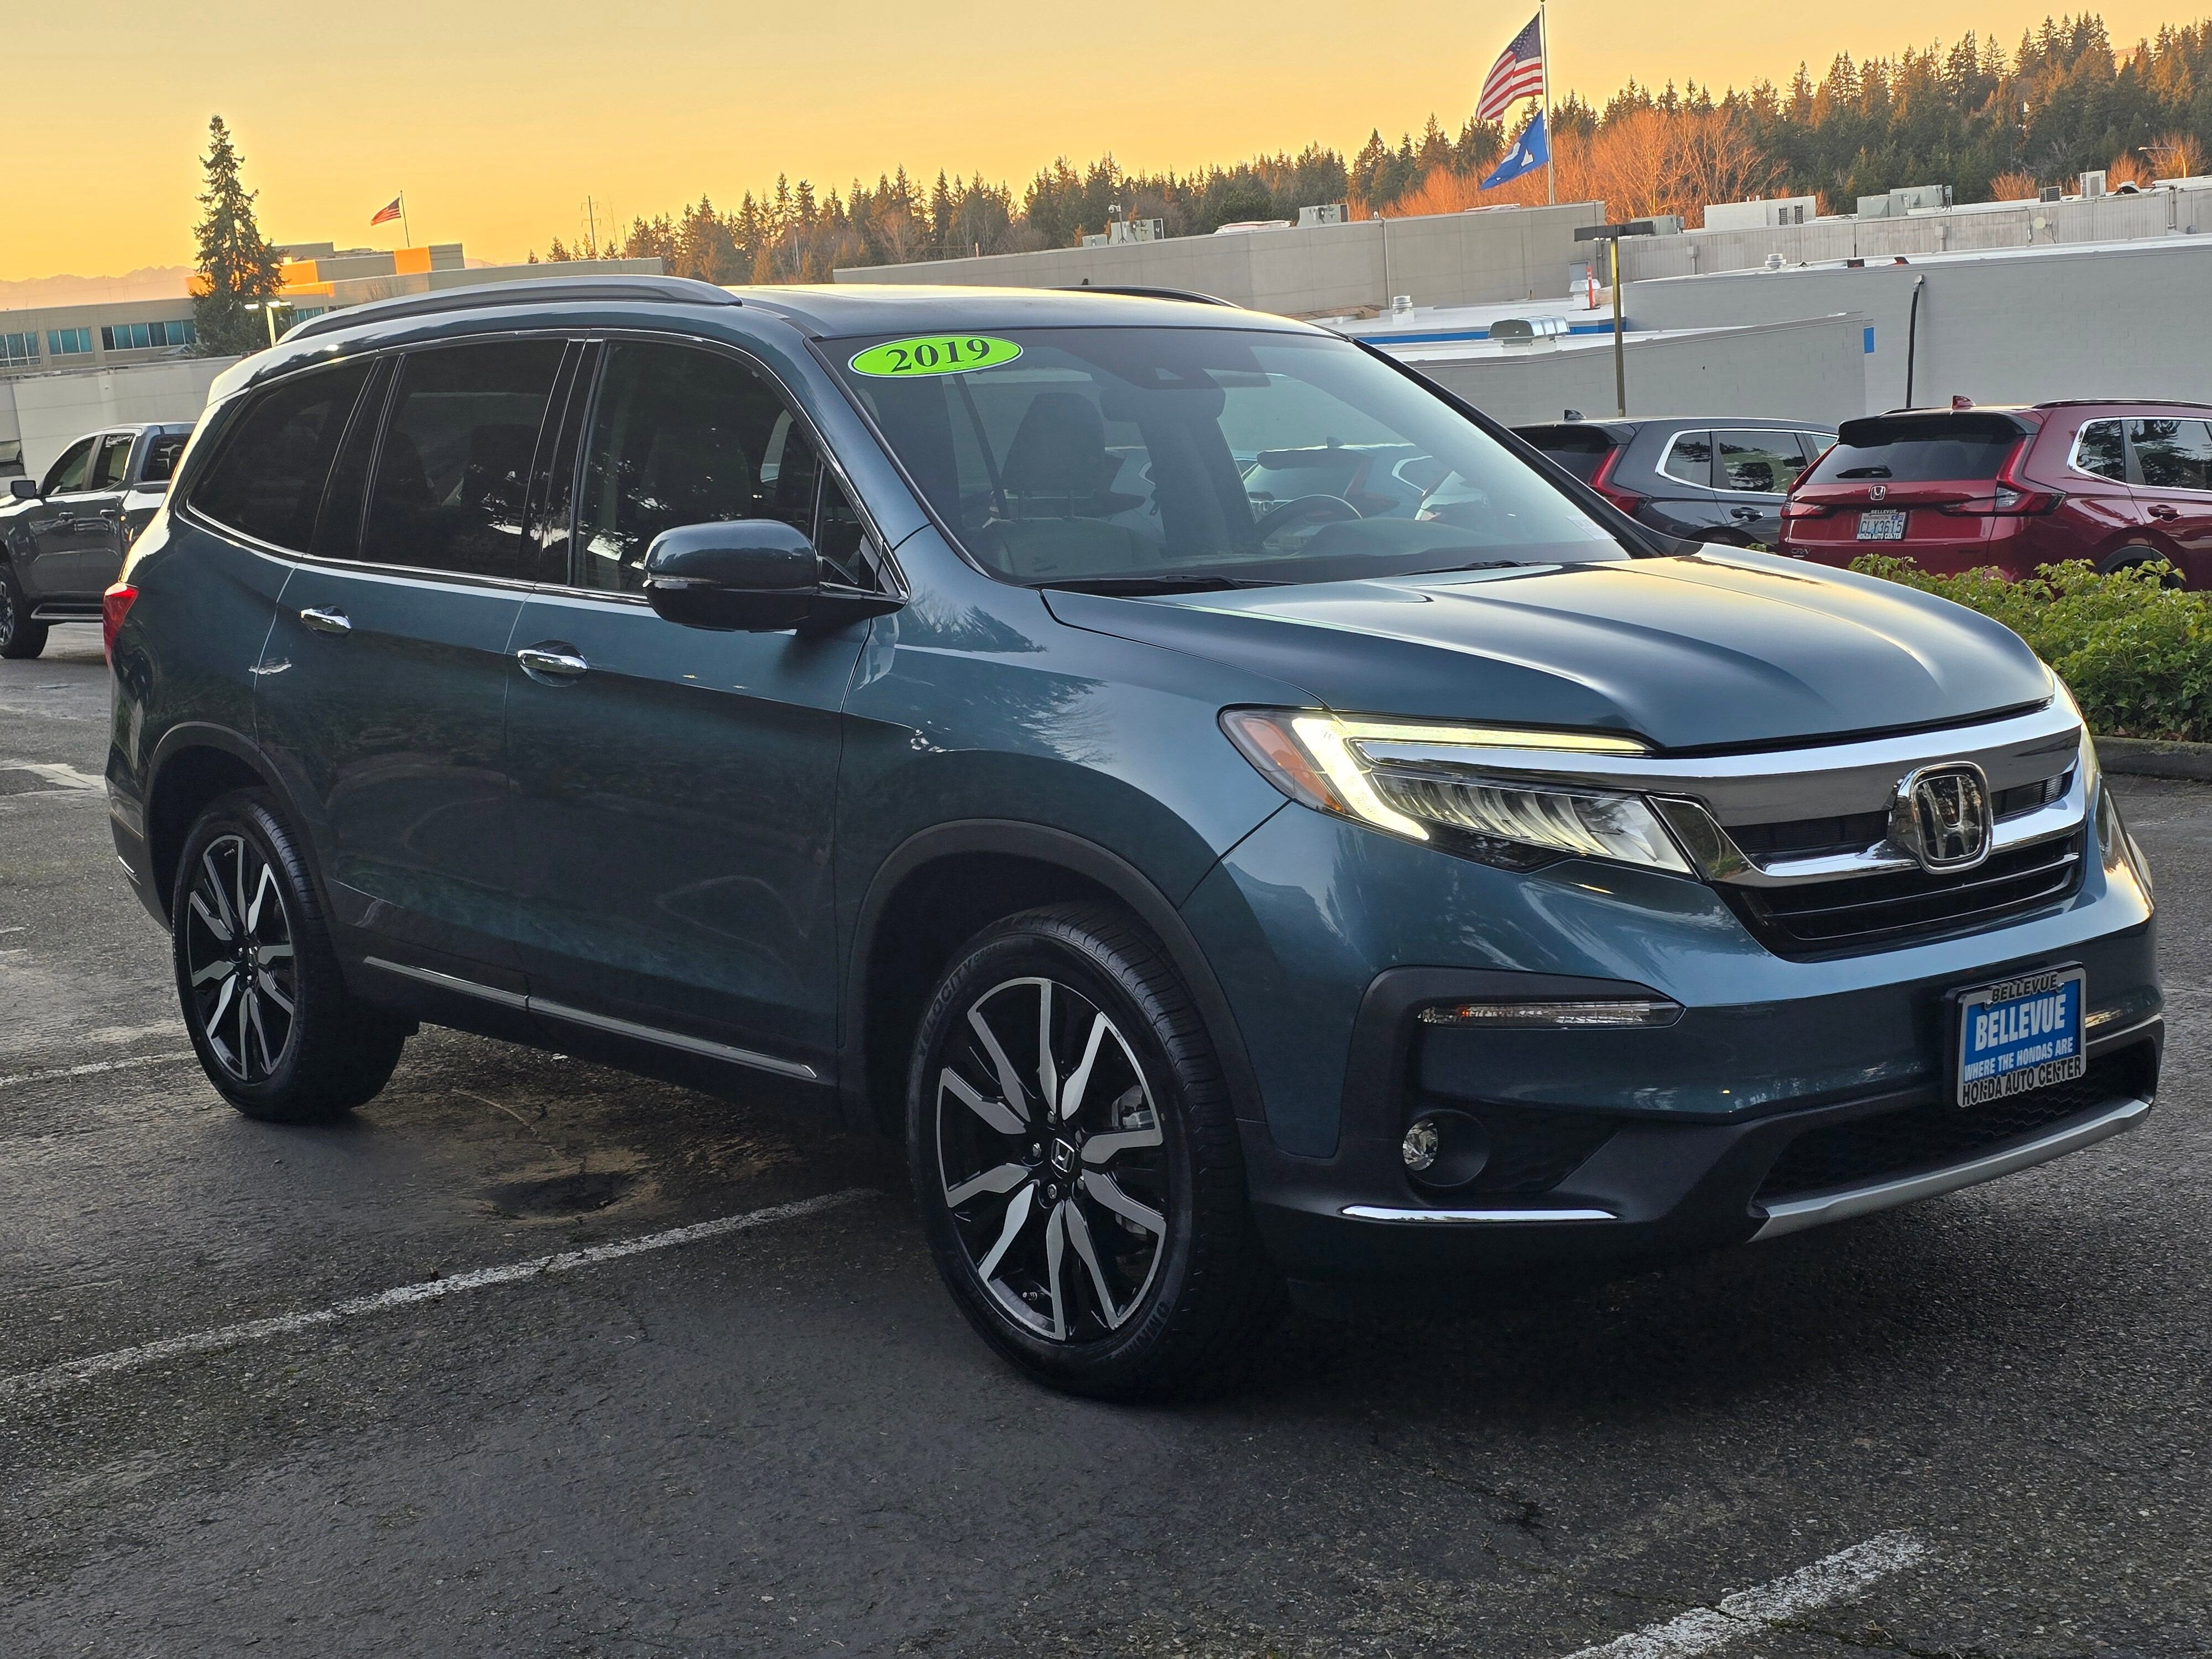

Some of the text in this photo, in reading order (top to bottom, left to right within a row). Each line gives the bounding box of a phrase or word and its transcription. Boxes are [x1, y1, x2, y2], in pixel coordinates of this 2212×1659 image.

[886, 338, 990, 372] 2019
[1860, 520, 1903, 534] CLY3615
[1992, 973, 2058, 1002] BELLEVUE
[1975, 994, 2067, 1051] BELLEVUE
[1964, 1036, 2074, 1082] WHERE THE HONDAS ARE
[1963, 1058, 2081, 1105] HONDA AUTO CENTER
